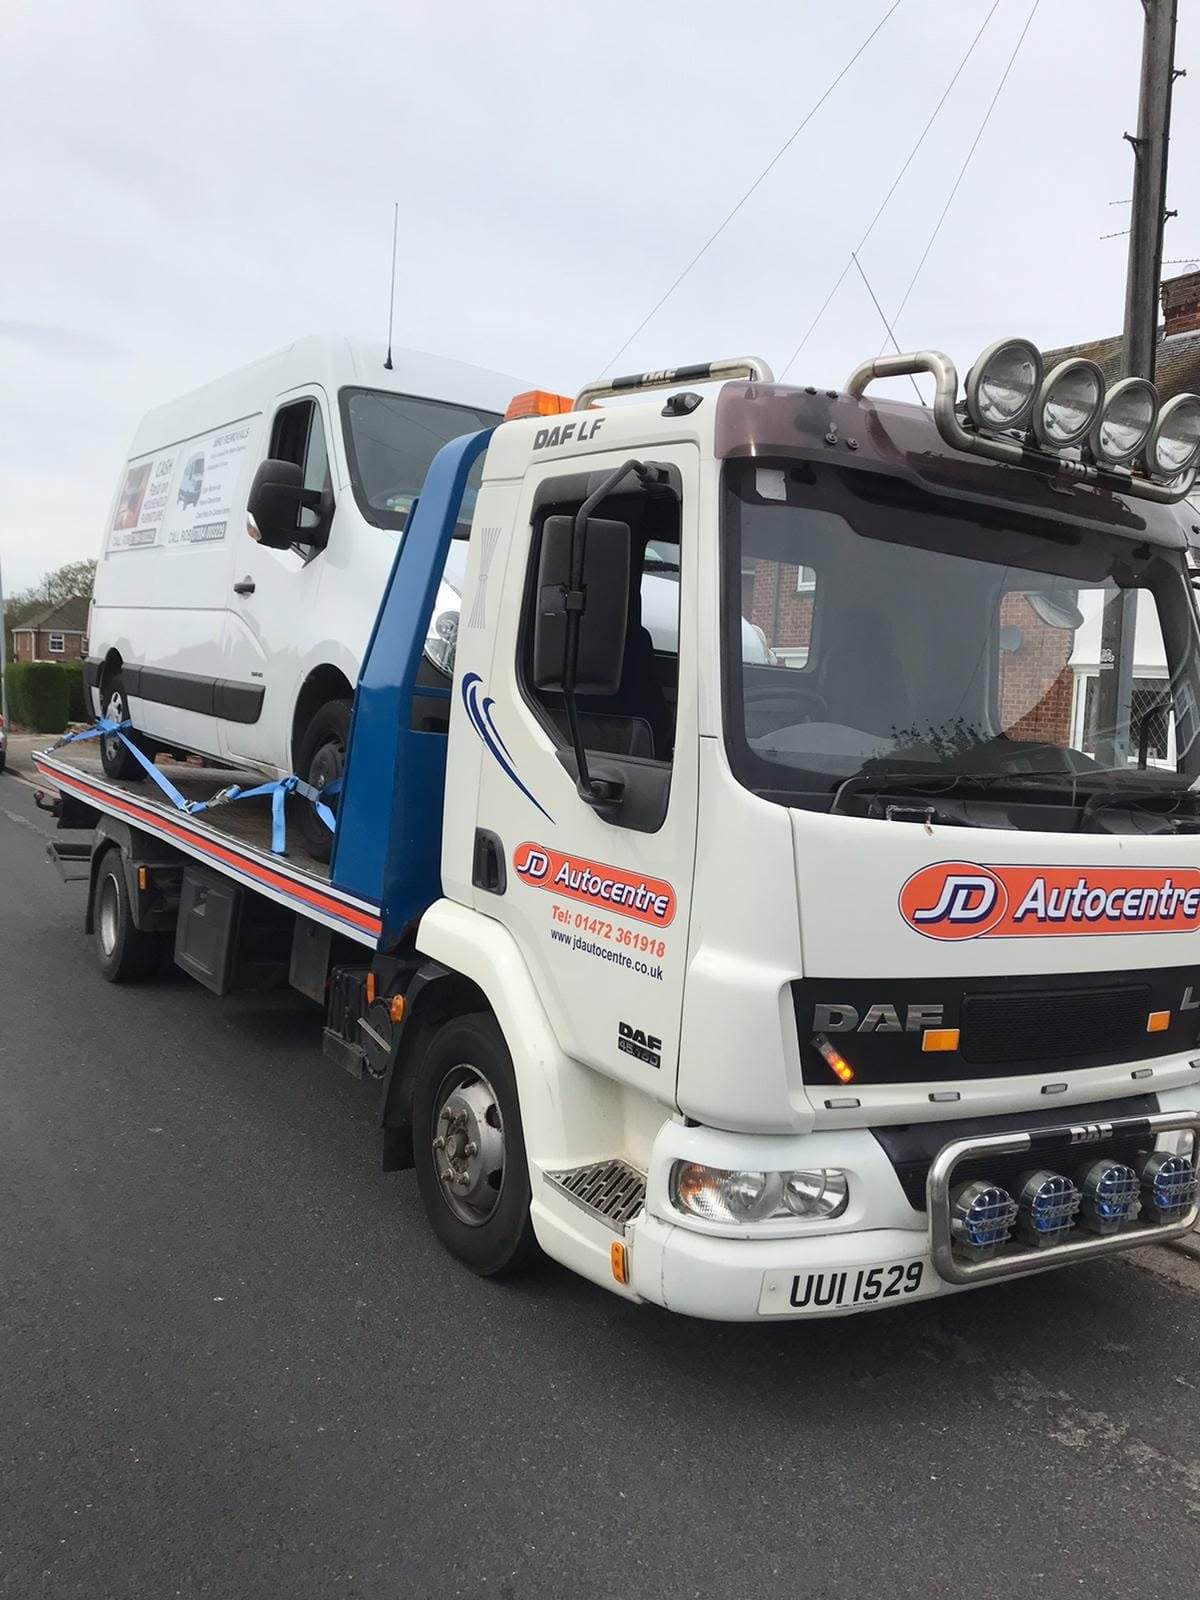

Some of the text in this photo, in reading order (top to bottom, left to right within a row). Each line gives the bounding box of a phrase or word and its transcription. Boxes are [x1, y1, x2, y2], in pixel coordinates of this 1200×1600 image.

[533, 418, 605, 450] DAF LF
[516, 850, 669, 917] JD Autocentre
[913, 874, 1200, 924] JD Autocentre
[550, 928, 664, 981] wwwjdautocentre.co.uk
[552, 905, 666, 958] Tel: 01472 361918
[619, 1021, 662, 1051] DAF
[812, 1003, 944, 1033] DAF
[790, 1261, 924, 1307] UUI 1529
